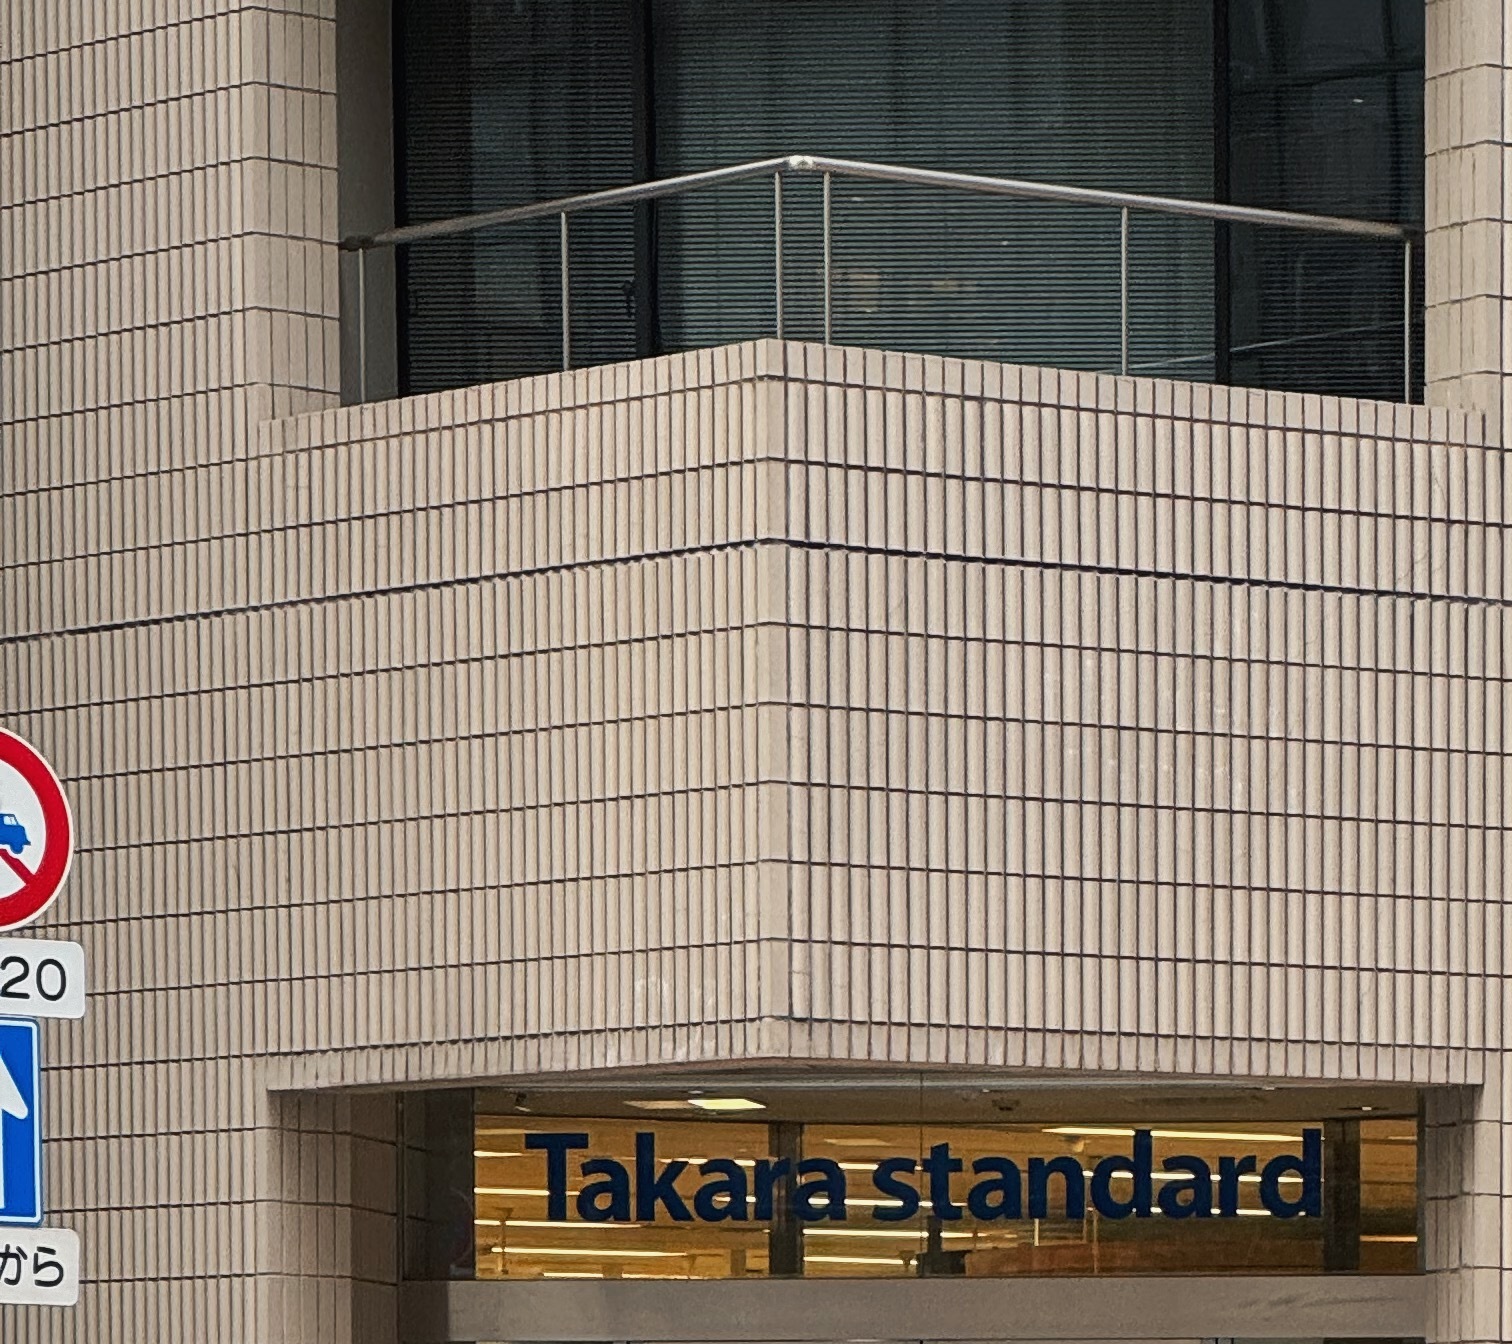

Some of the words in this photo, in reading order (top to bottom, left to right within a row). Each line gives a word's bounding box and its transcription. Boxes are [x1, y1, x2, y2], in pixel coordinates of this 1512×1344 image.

[0, 956, 66, 1001] 20
[525, 1132, 847, 1222] Takara
[872, 1129, 1322, 1222] standard
[0, 1244, 64, 1288] から
